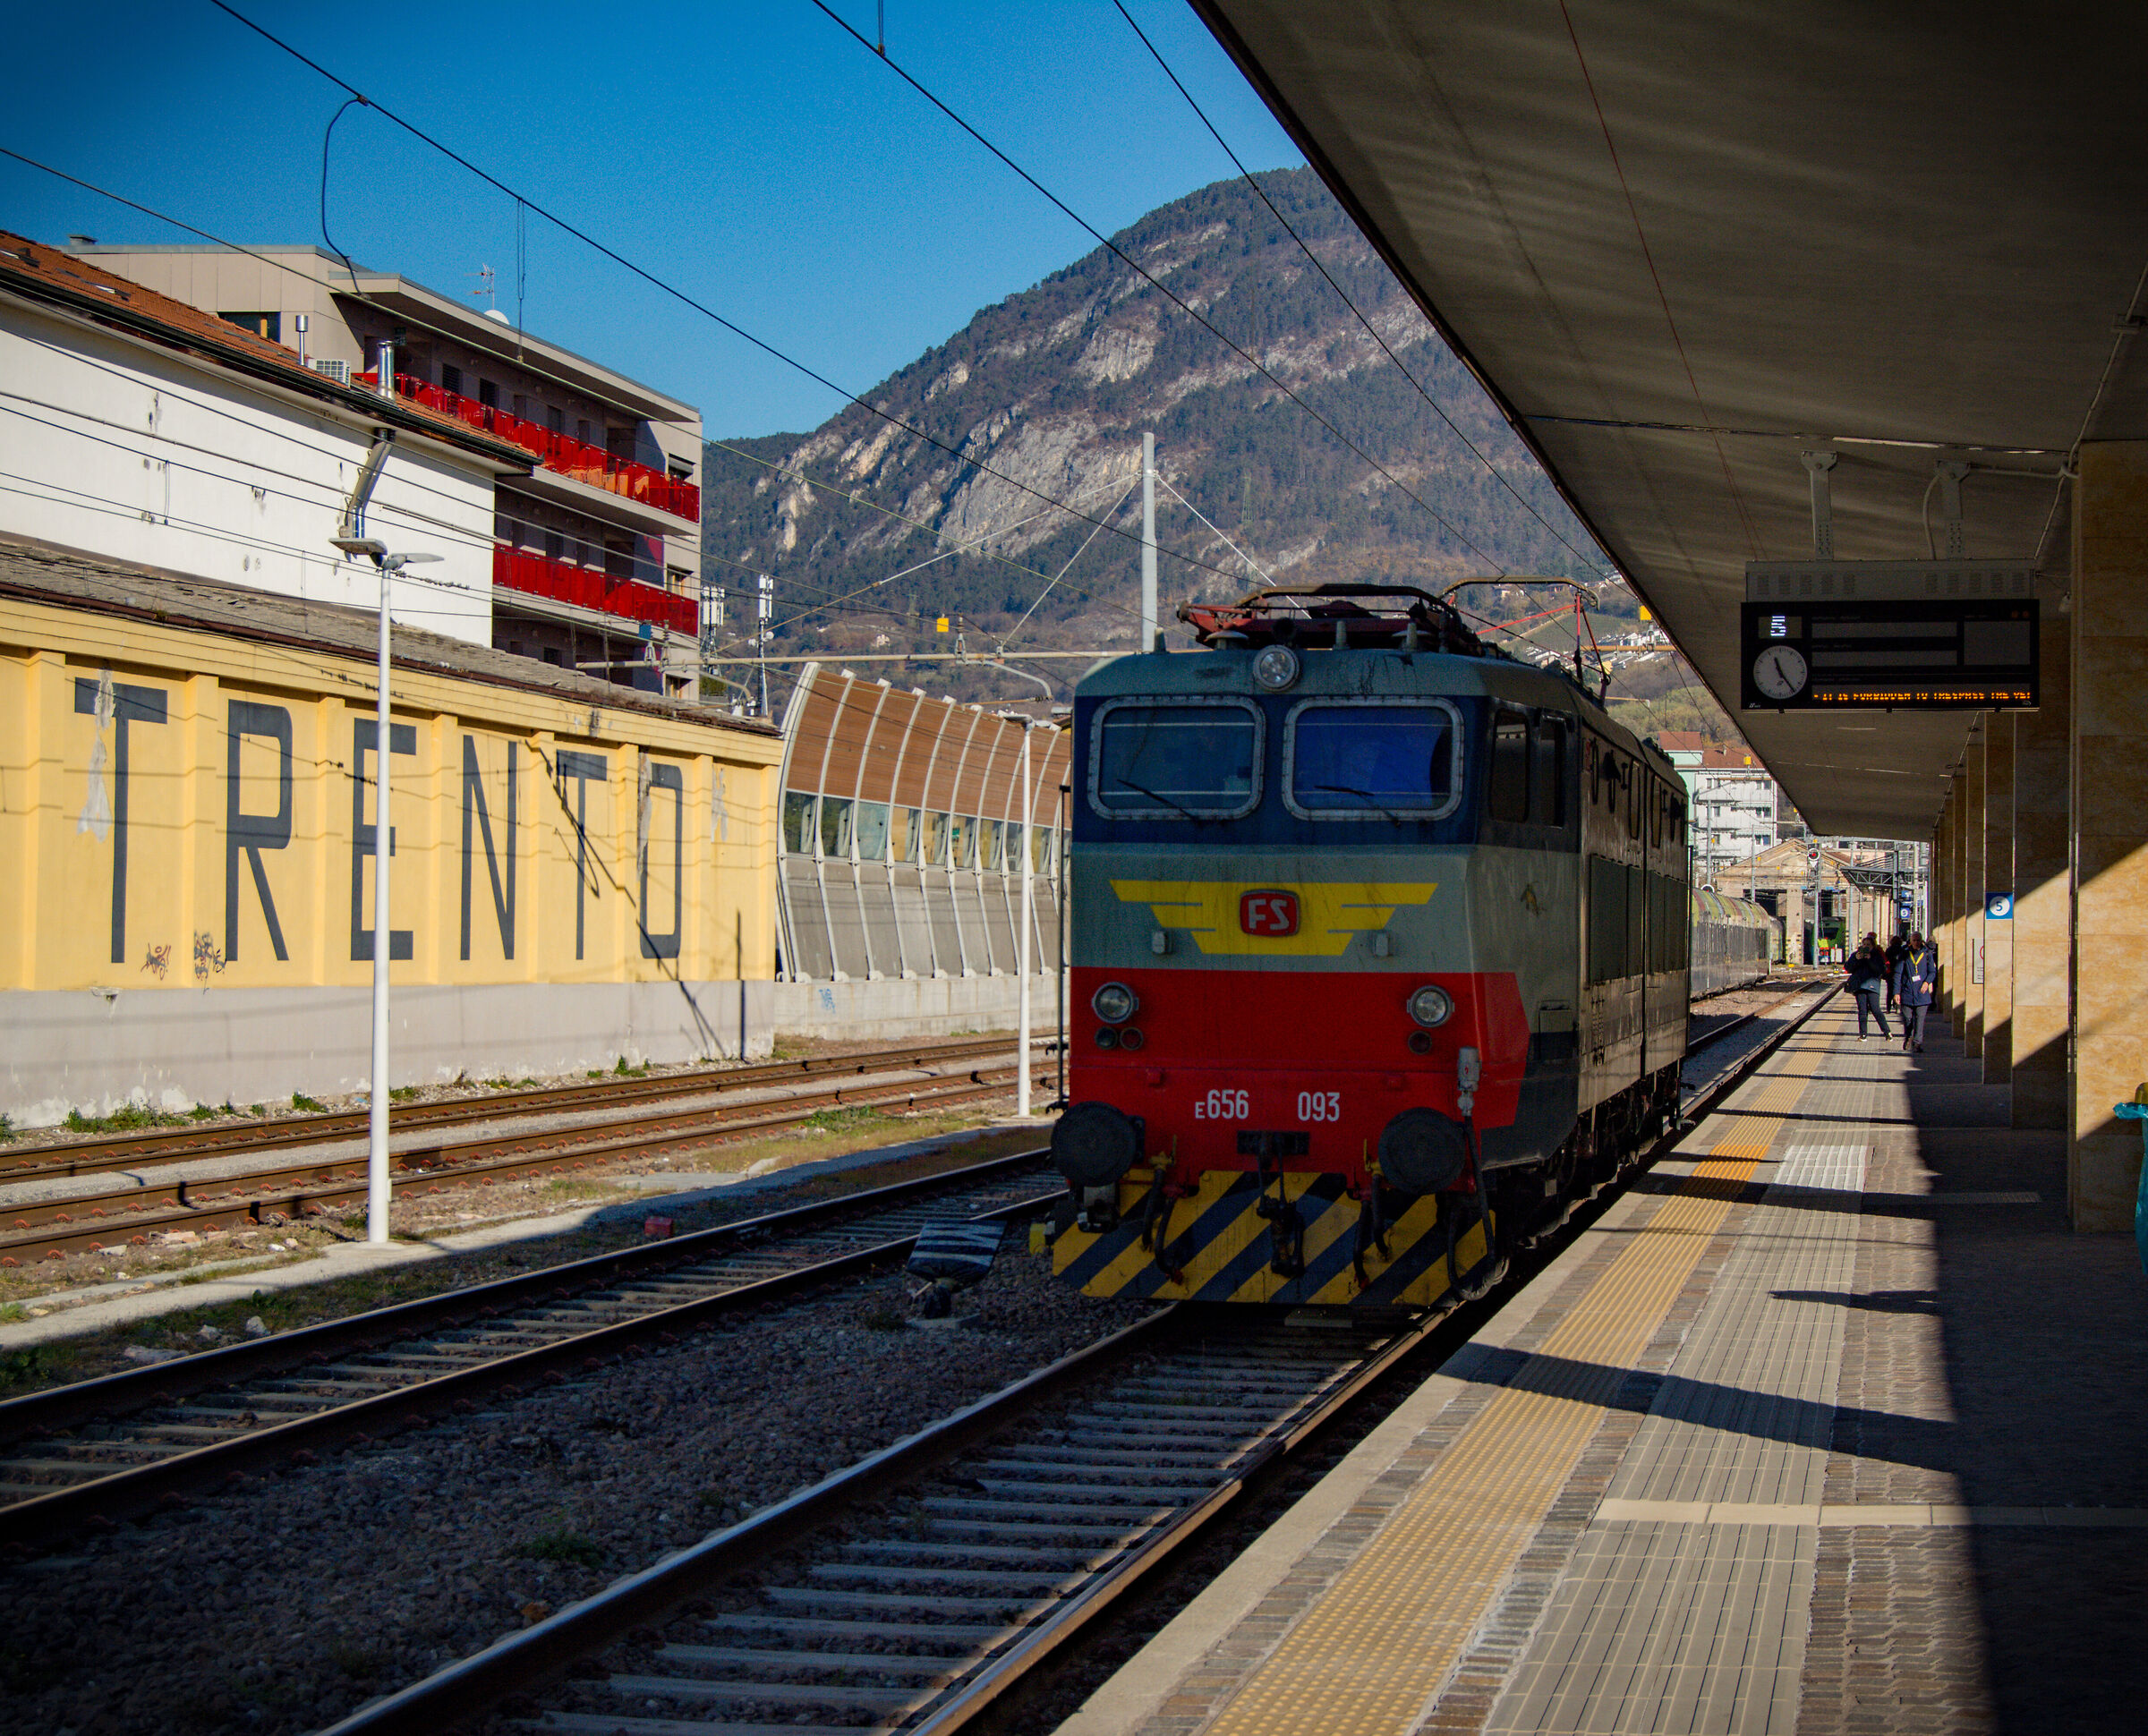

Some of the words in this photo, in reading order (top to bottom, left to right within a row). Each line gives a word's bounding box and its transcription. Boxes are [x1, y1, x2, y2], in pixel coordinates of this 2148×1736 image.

[74, 677, 683, 964] TRENTO
[1249, 898, 1289, 931] FS
[1996, 901, 2003, 912] 5
[1195, 1089, 1249, 1119] E656
[1298, 1091, 1341, 1122] 093
